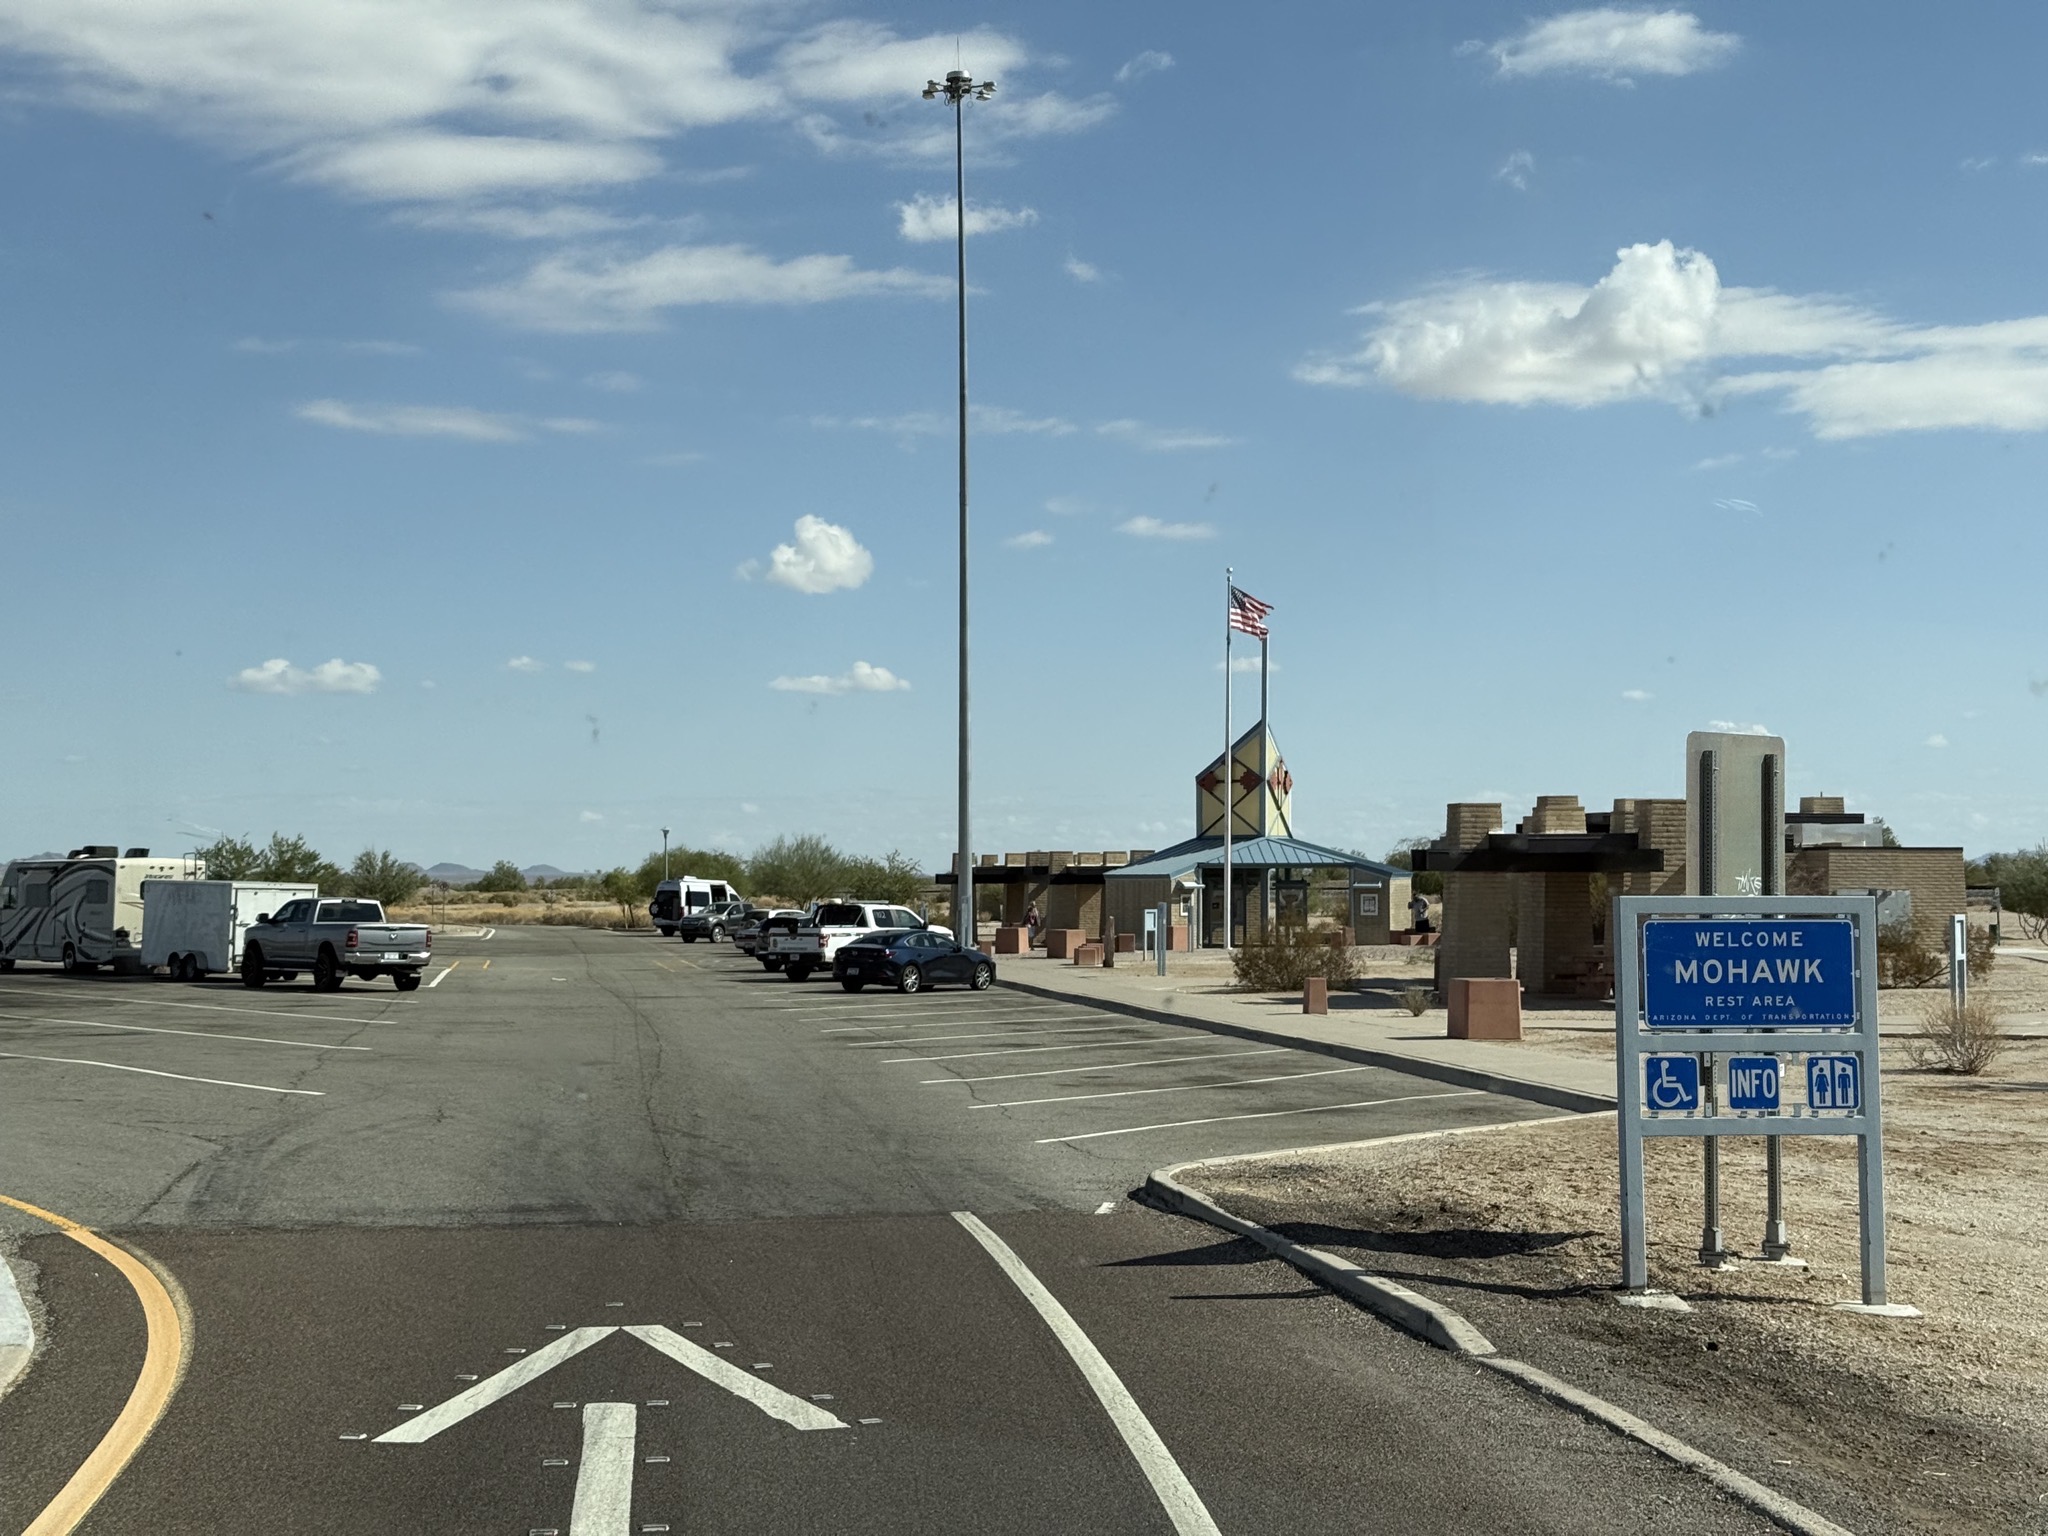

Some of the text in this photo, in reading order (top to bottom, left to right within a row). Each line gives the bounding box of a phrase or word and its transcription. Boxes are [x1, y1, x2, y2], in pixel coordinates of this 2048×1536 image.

[1695, 931, 1803, 947] WELCOME
[1675, 958, 1824, 984] MOHAWK
[1705, 995, 1796, 1007] REST AREA
[1762, 1013, 1850, 1021] TRANSPORTATION
[1731, 1068, 1776, 1099] INFO
